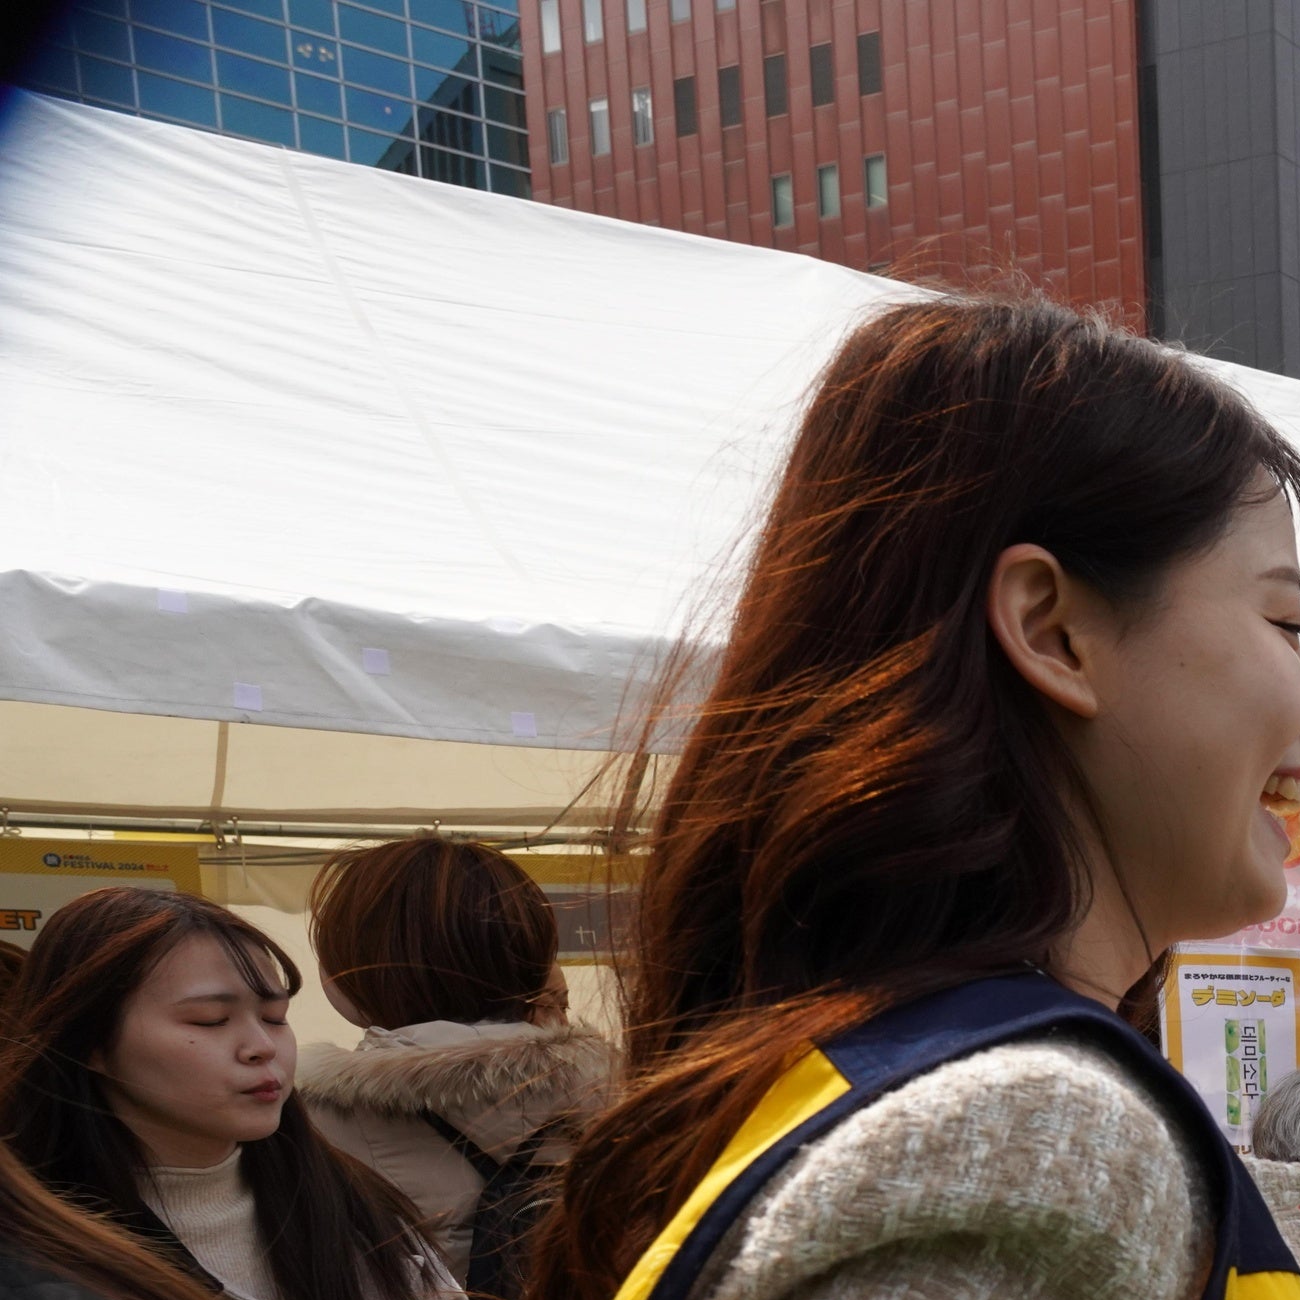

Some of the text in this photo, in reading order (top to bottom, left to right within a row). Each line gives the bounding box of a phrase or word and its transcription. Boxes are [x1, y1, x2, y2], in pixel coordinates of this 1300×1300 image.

[63, 860, 115, 870] FESTIVAL
[118, 863, 144, 871] 2024
[1240, 1026, 1260, 1100] 데미소다
